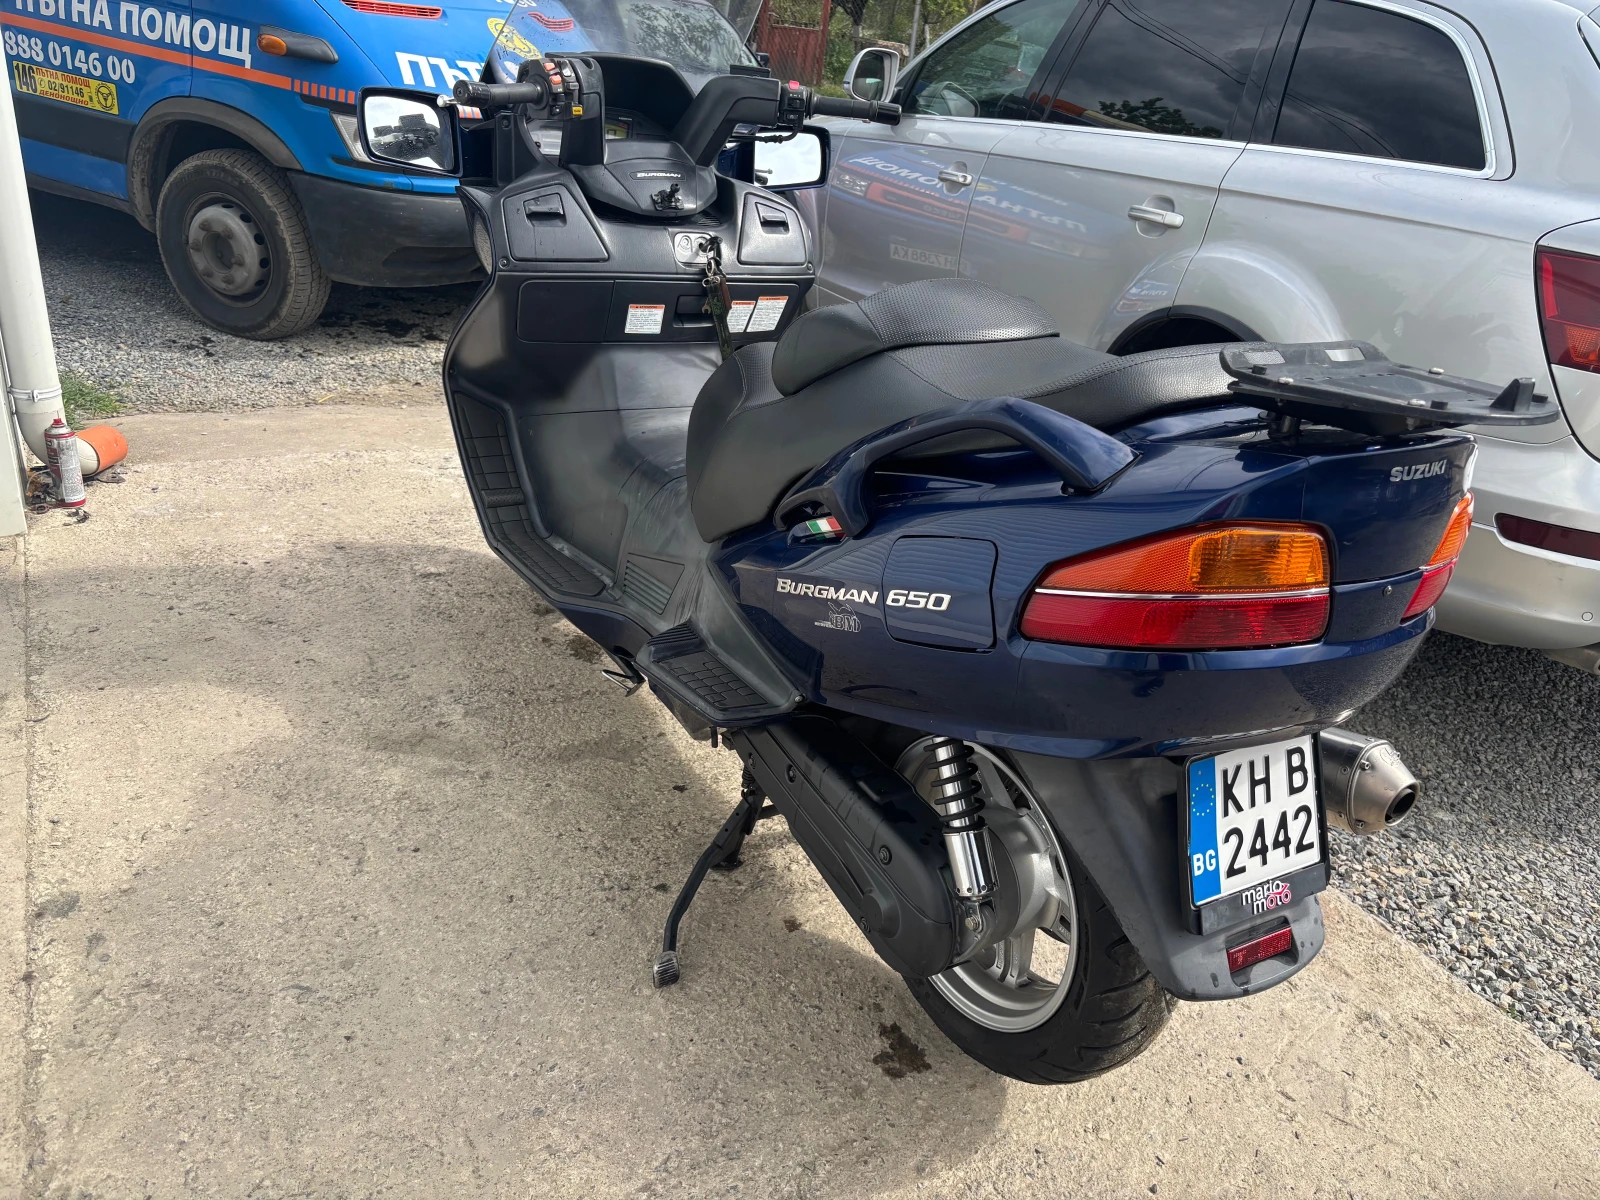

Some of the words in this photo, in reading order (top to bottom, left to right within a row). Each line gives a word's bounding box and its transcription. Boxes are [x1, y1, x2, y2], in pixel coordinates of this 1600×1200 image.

[120, 1, 251, 69] ПОМОЩ
[35, 67, 59, 80] ПЪТНА
[61, 73, 91, 88] ПОМОЩ
[48, 41, 103, 77] 0146
[107, 55, 136, 84] 00
[395, 51, 486, 89] ПЪТ
[14, 63, 38, 93] 146
[39, 89, 89, 106] ДЕНОНОЩНО
[1389, 460, 1447, 482] SUZUKI
[776, 577, 879, 605] BURGMAN
[886, 589, 952, 611] 650
[1221, 754, 1272, 818] KH
[1286, 745, 1309, 797] B
[1222, 804, 1315, 880] 2442
[1193, 849, 1217, 877] BG
[1242, 880, 1282, 906] mario
[1253, 889, 1292, 915] moto
